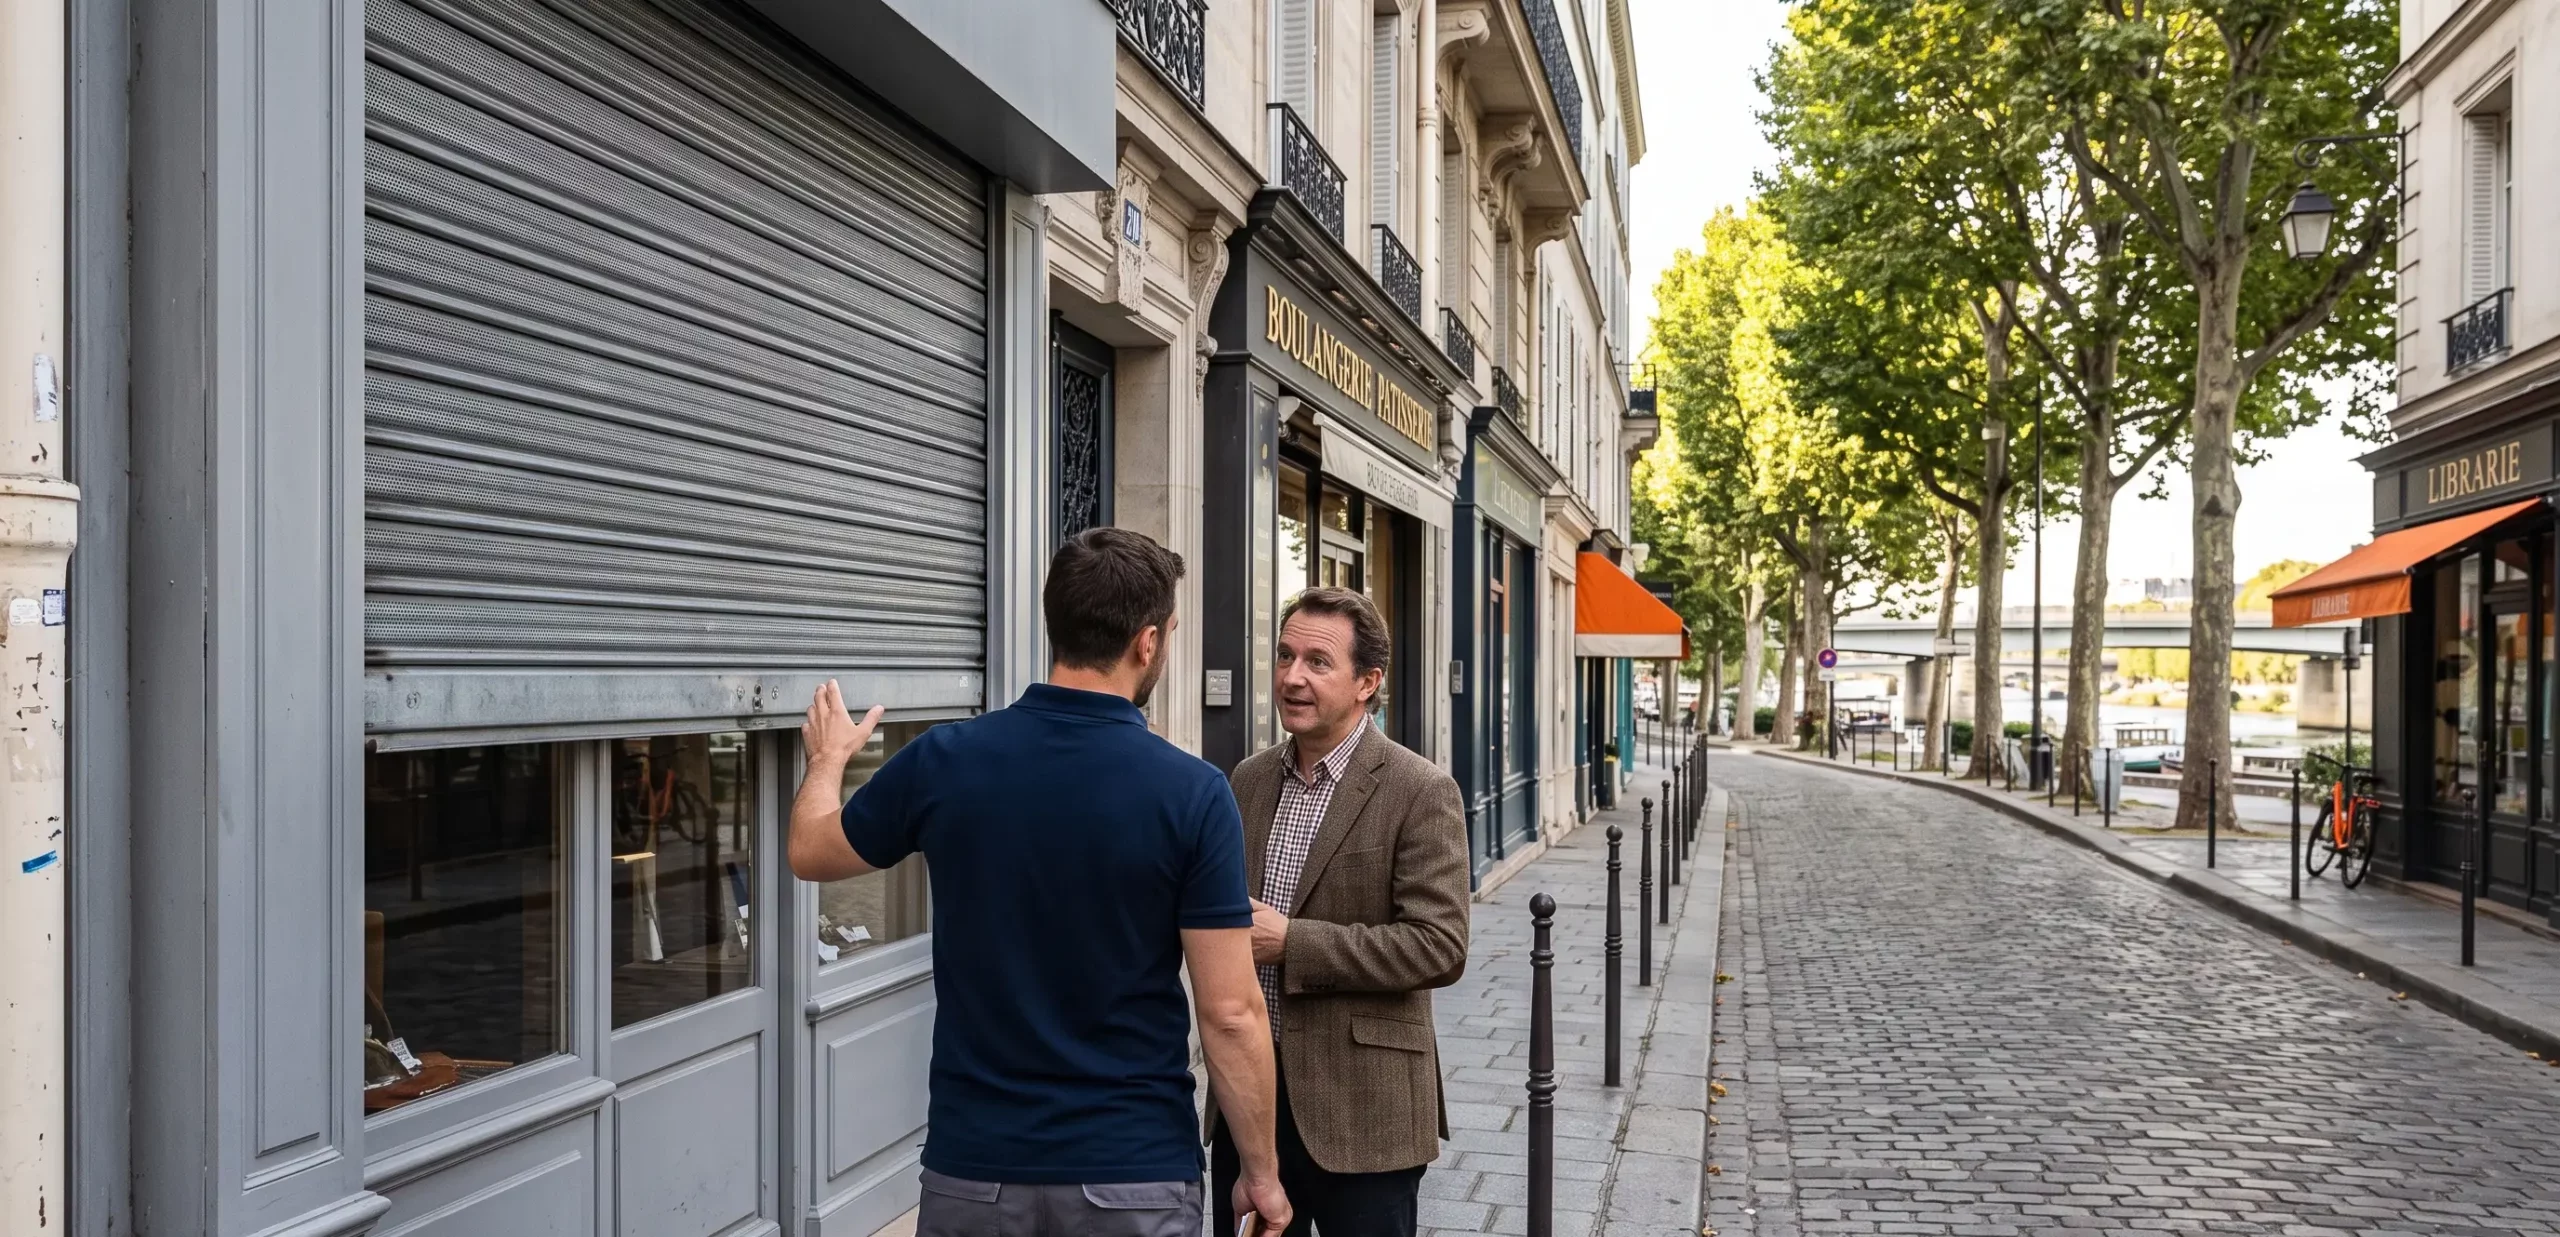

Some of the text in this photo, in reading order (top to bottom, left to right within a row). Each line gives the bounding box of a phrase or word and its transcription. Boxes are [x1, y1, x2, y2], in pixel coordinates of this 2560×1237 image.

[1266, 284, 1433, 453] BOULANGERIE PATISSERIE
[2428, 441, 2521, 504] LIBRARIE
